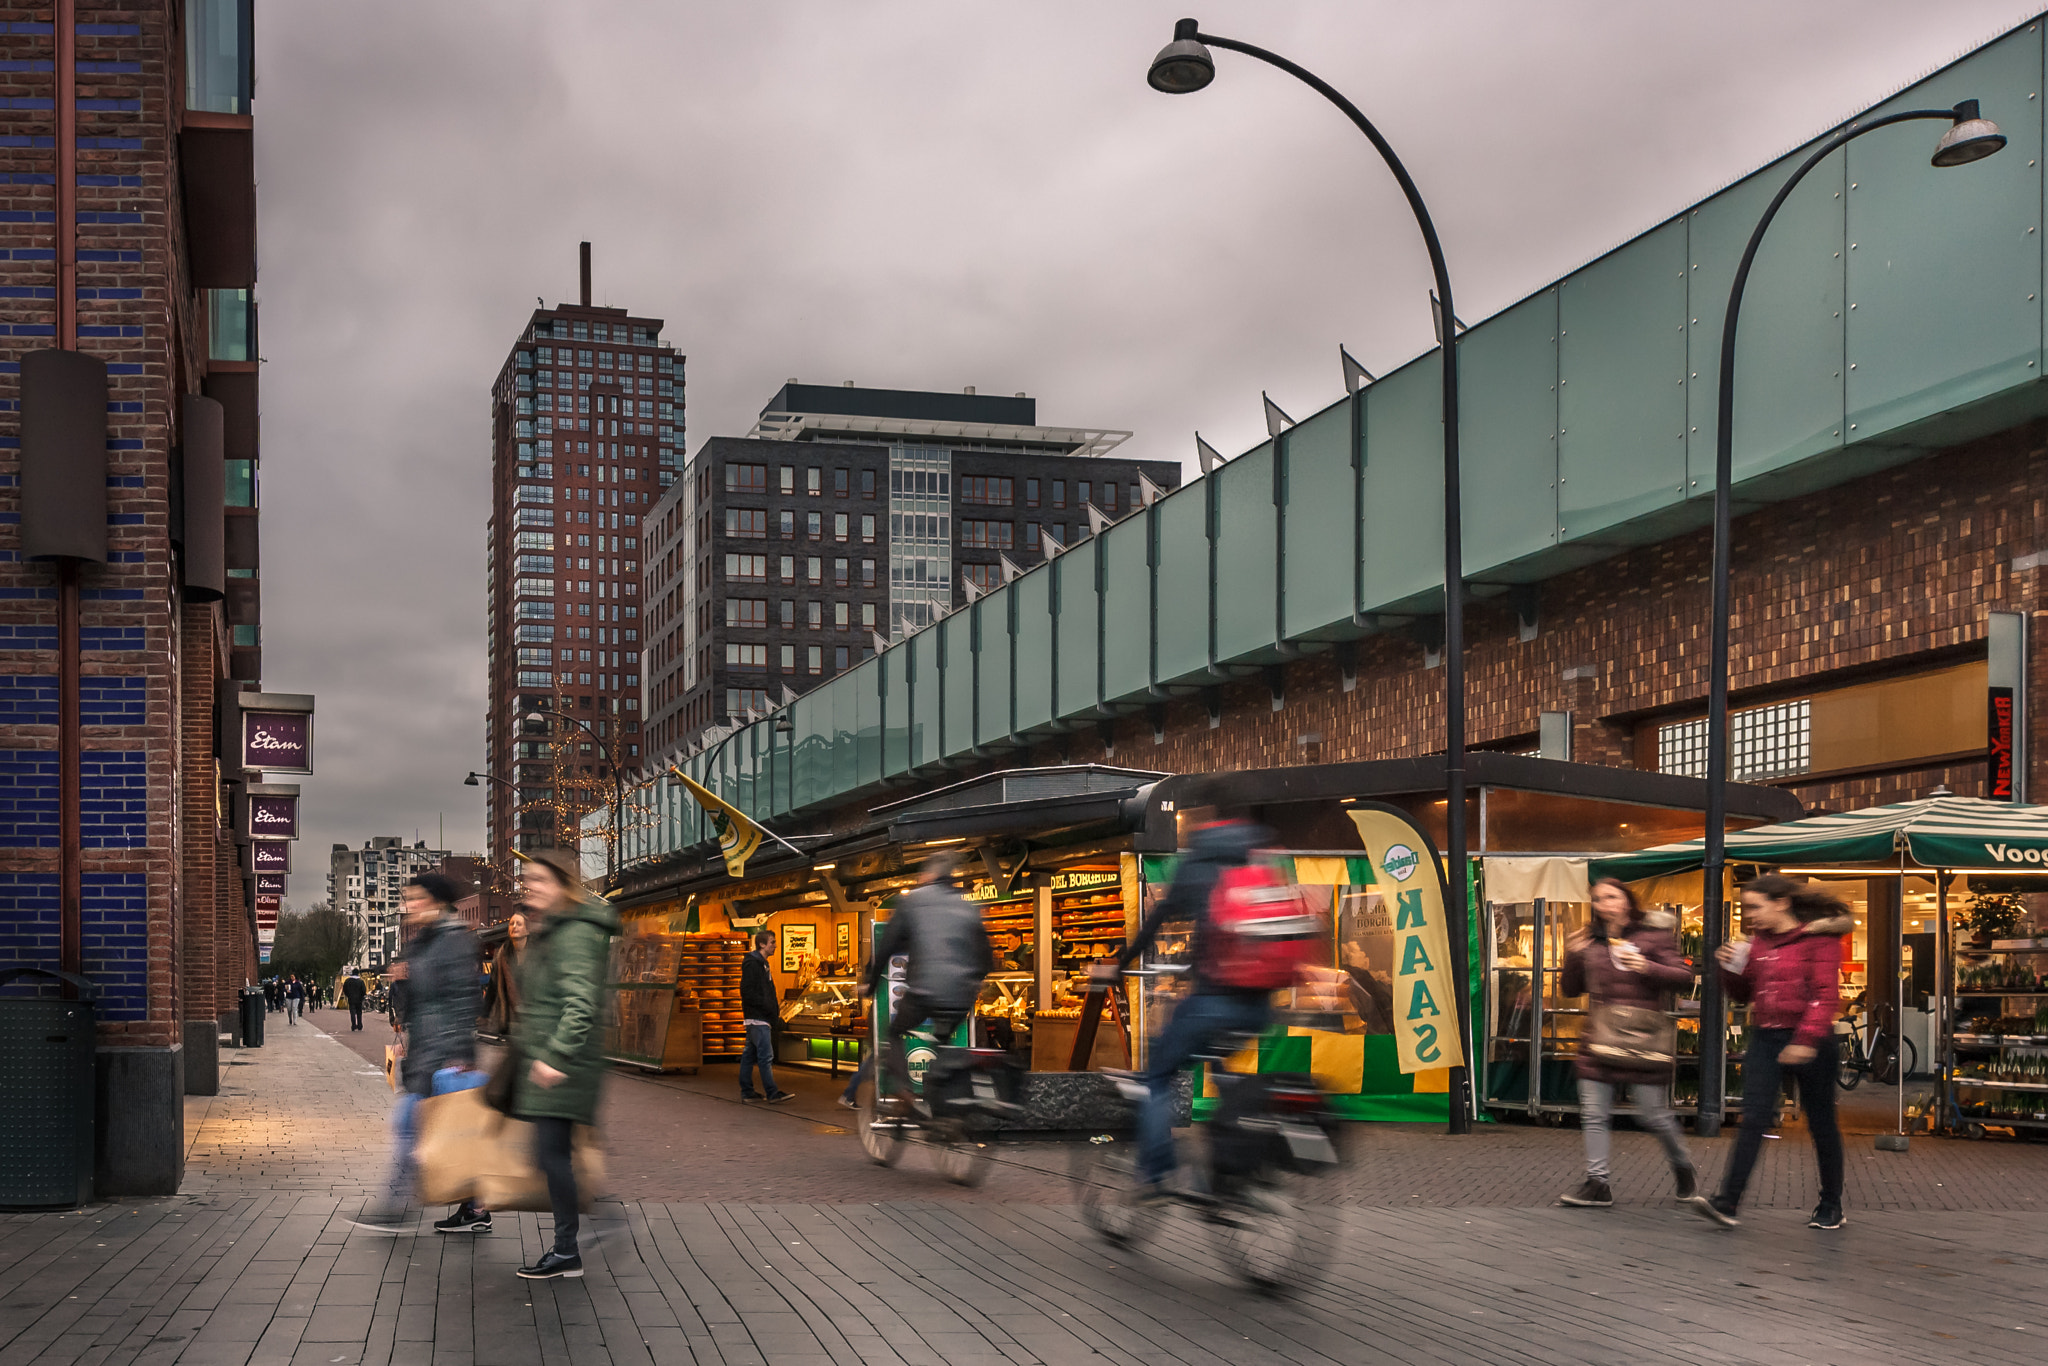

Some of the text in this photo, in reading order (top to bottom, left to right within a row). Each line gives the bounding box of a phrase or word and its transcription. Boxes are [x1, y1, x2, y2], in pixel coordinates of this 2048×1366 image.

[250, 731, 302, 750] Etam
[254, 809, 292, 824] Etam
[256, 851, 286, 863] Etam
[259, 880, 283, 889] Etam
